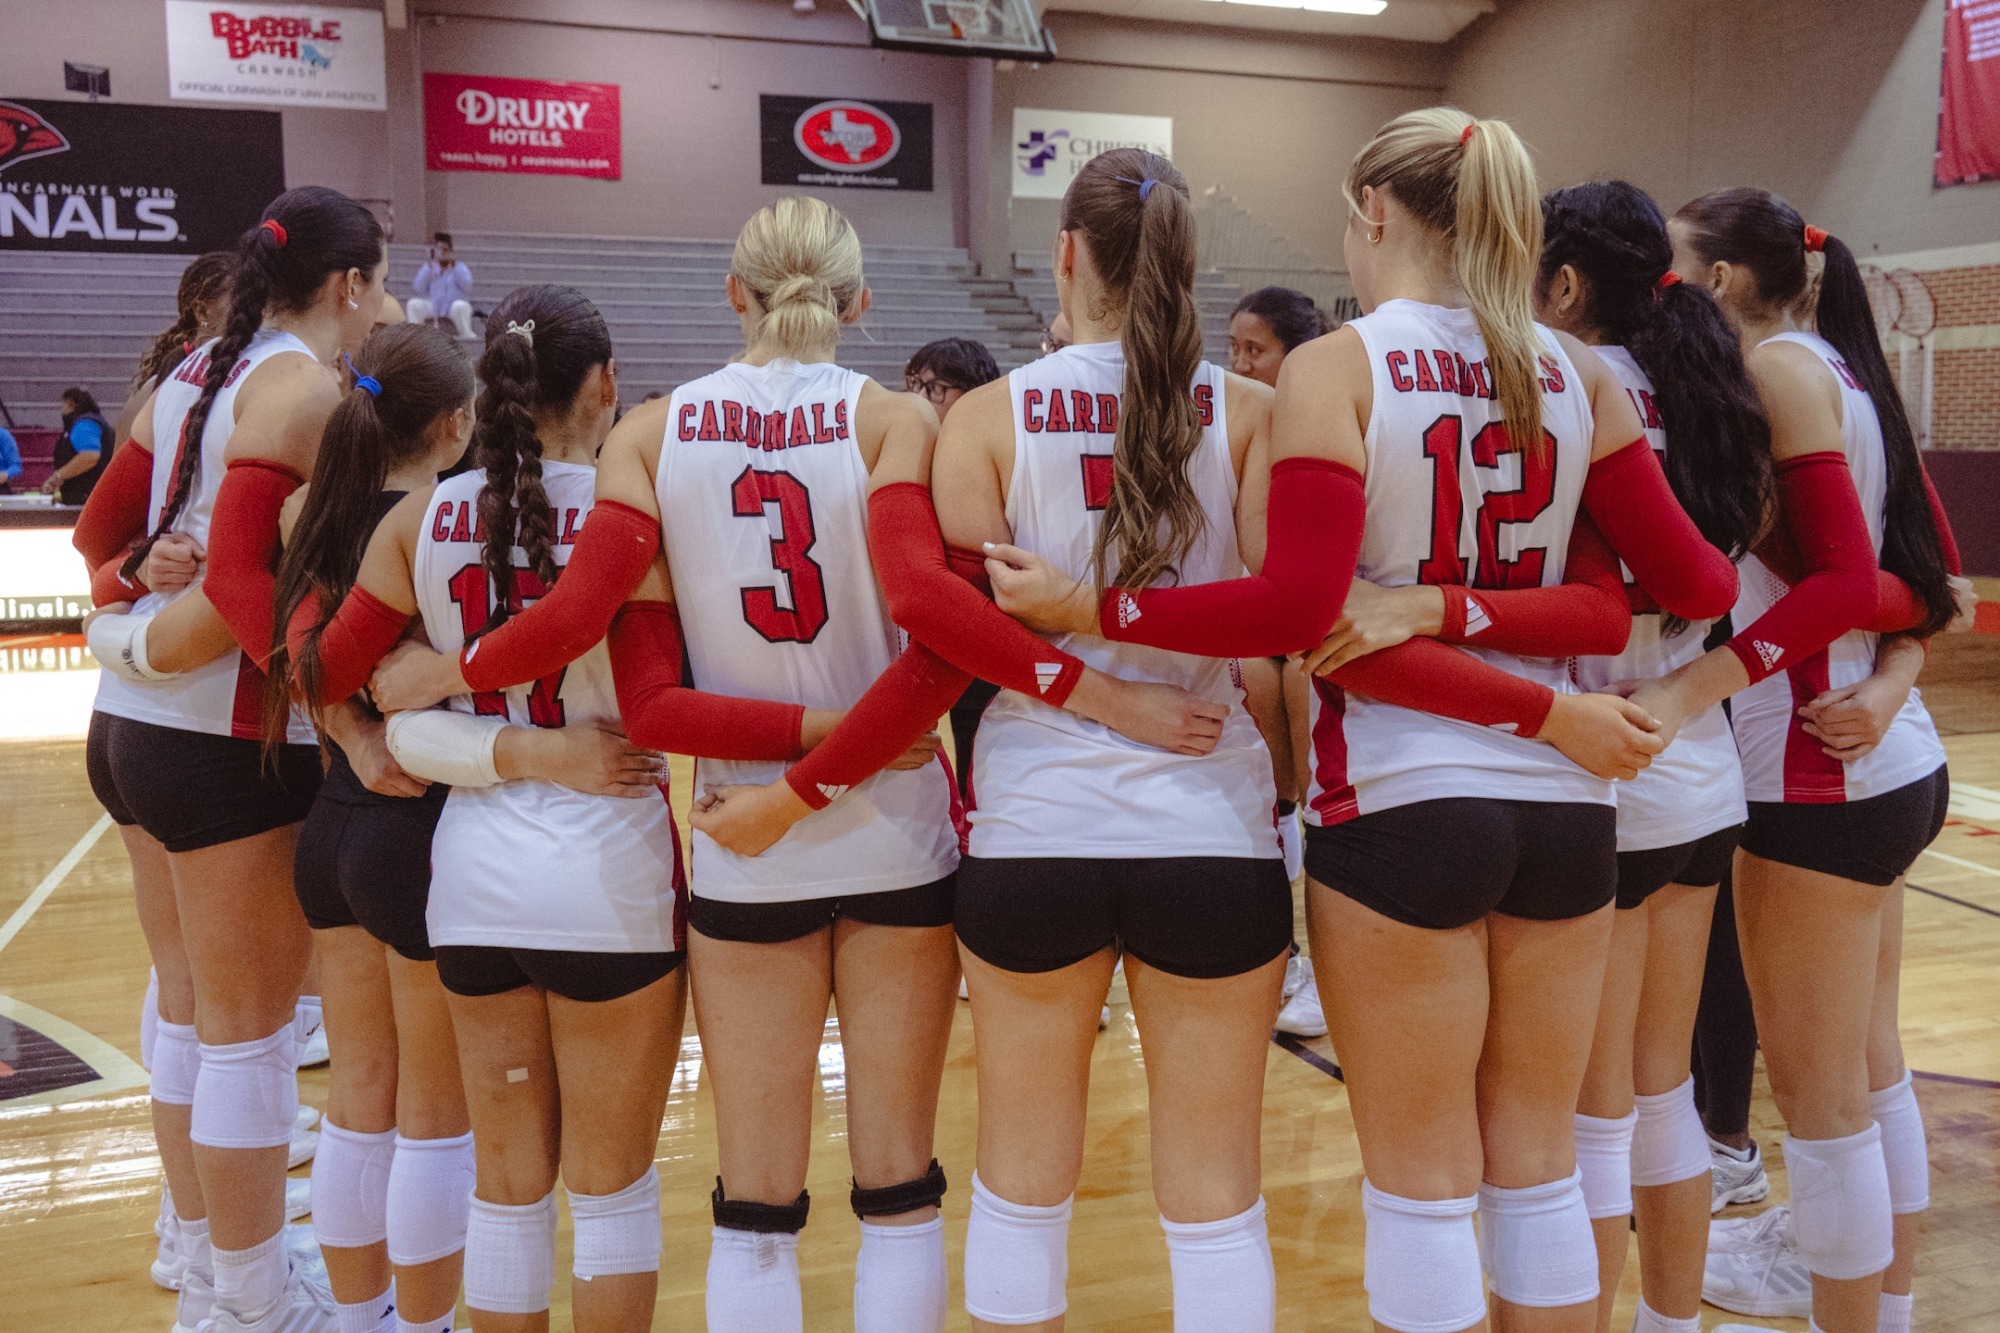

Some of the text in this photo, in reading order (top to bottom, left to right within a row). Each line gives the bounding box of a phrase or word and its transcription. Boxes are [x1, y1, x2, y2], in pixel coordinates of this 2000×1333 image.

[210, 12, 341, 41] BUBBLE
[226, 37, 298, 59] BATH
[237, 63, 317, 78] CARWASH
[178, 82, 225, 94] OFFICIAL
[227, 84, 281, 97] CARWASH
[284, 88, 297, 97] OF
[324, 90, 378, 102] ATHLETICS
[456, 89, 590, 130] DRURY
[489, 128, 564, 147] HOTELS
[1386, 349, 1566, 401] CARDIS
[678, 399, 849, 452] CARDINALS
[1024, 384, 1214, 434] CARDS
[1417, 413, 1558, 590] 12
[730, 463, 829, 644] 3
[0, 597, 90, 620] inals.
[1118, 592, 1128, 629] adidas
[1752, 639, 1774, 672] adidas
